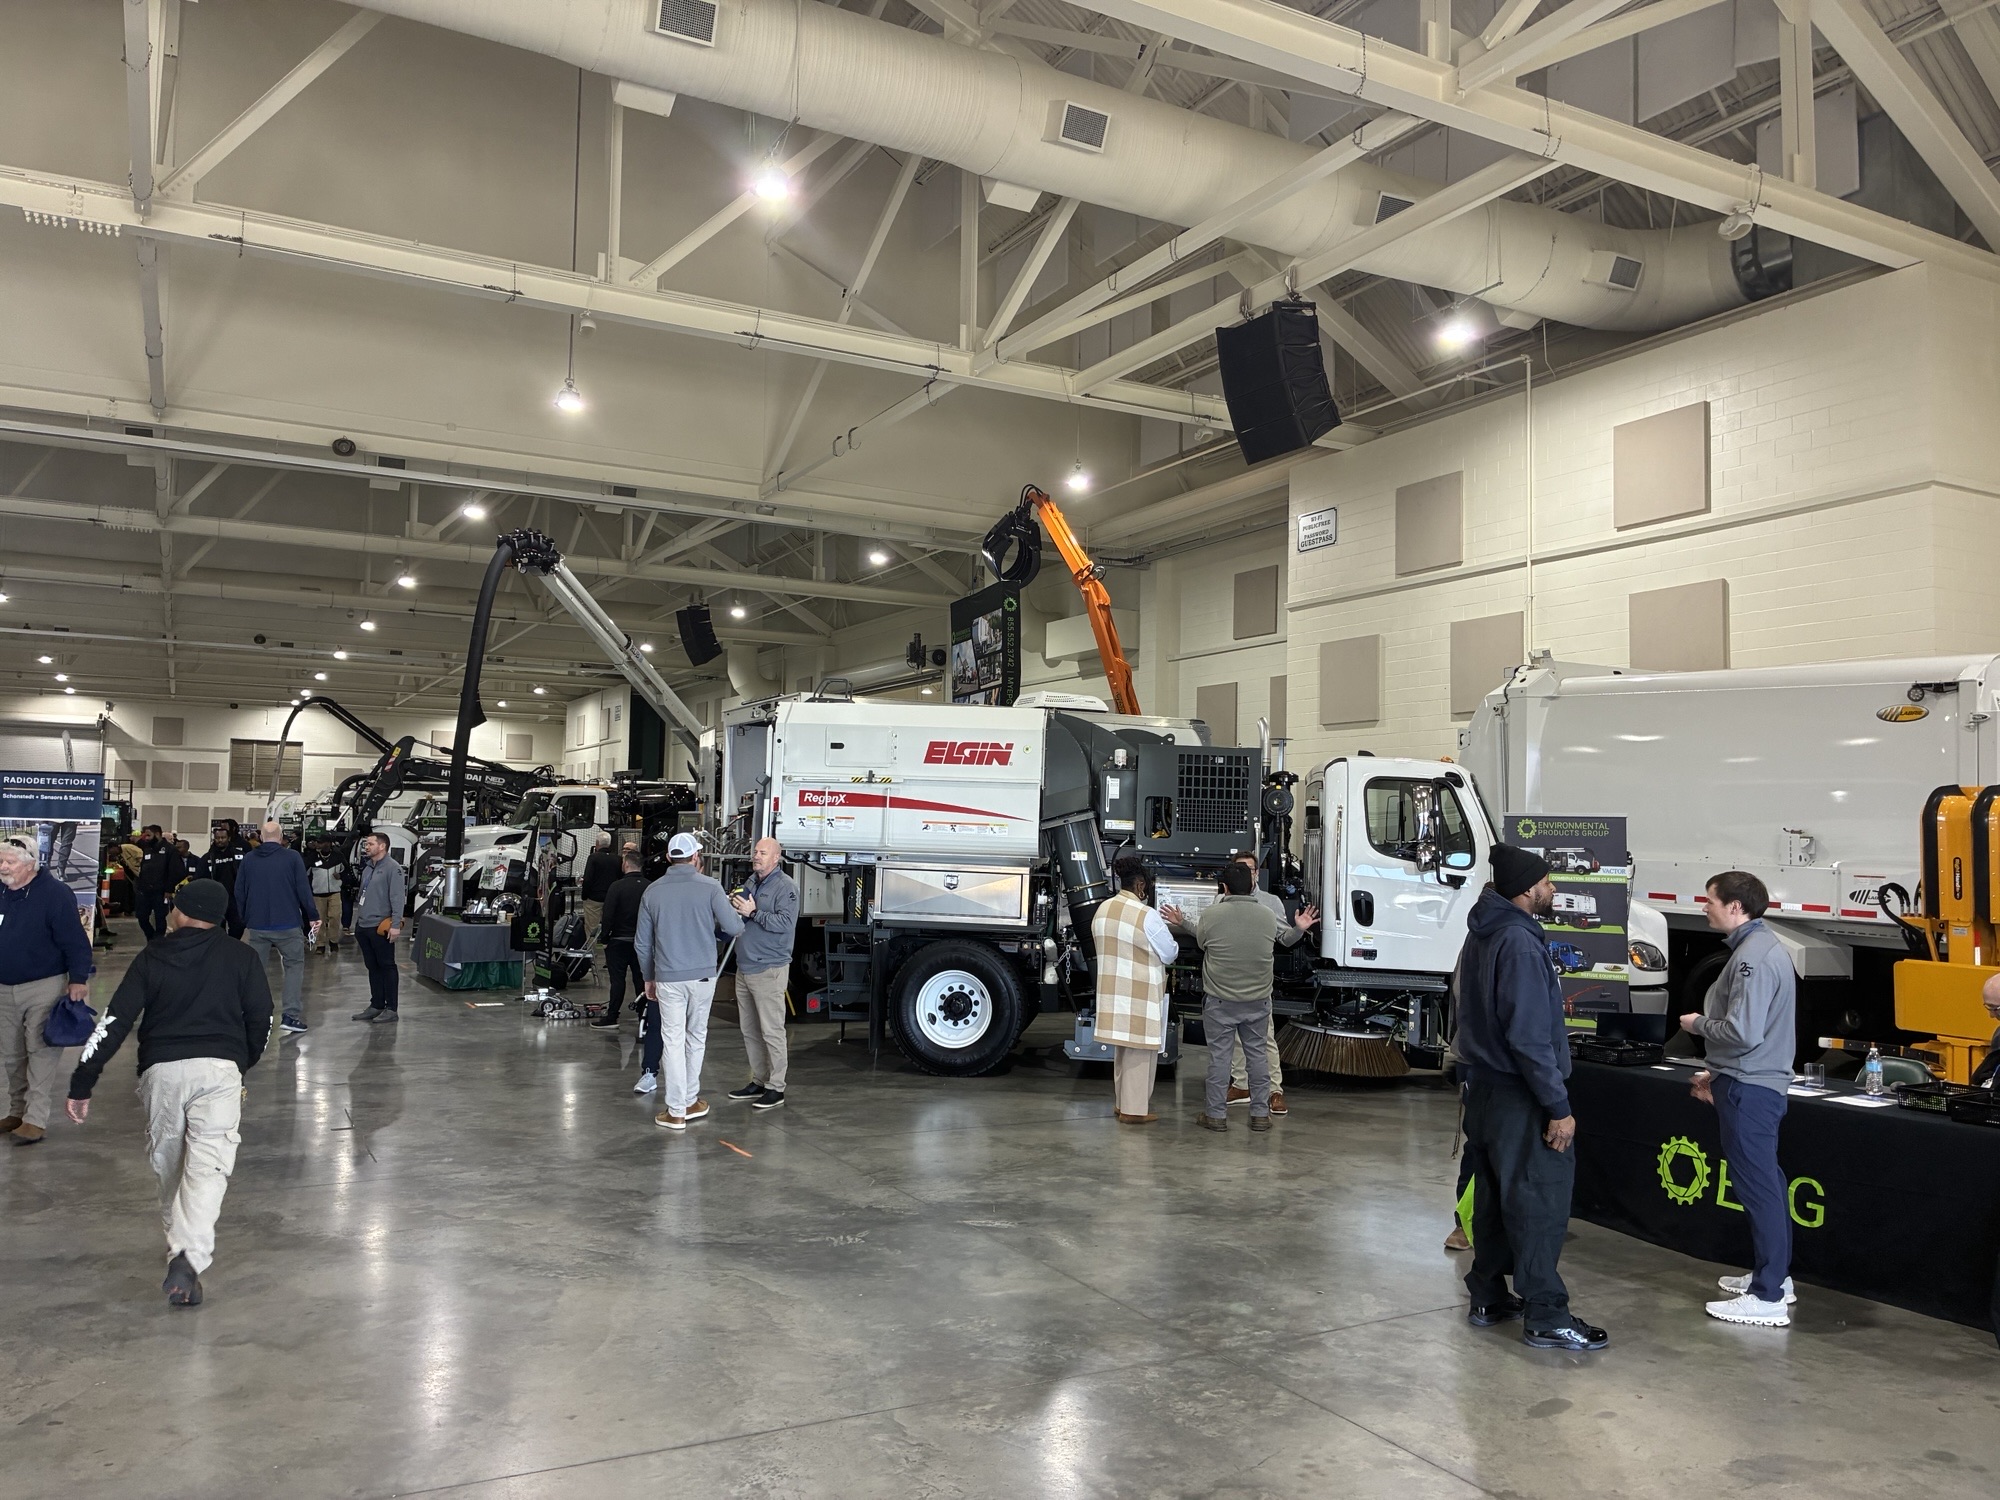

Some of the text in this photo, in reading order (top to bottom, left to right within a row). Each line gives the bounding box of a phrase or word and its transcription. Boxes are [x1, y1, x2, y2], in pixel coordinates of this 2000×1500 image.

[1301, 534, 1333, 548] GUESTPASS
[1304, 529, 1329, 540] PASSWORD
[1007, 616, 1015, 667] 855.552.3742
[923, 741, 1014, 766] ELGIN
[3, 776, 87, 786] RADIODETECTION
[1538, 821, 1610, 830] ENVIRONMENTAL
[1739, 962, 1754, 977] 25
[1716, 1158, 1825, 1228] EG
